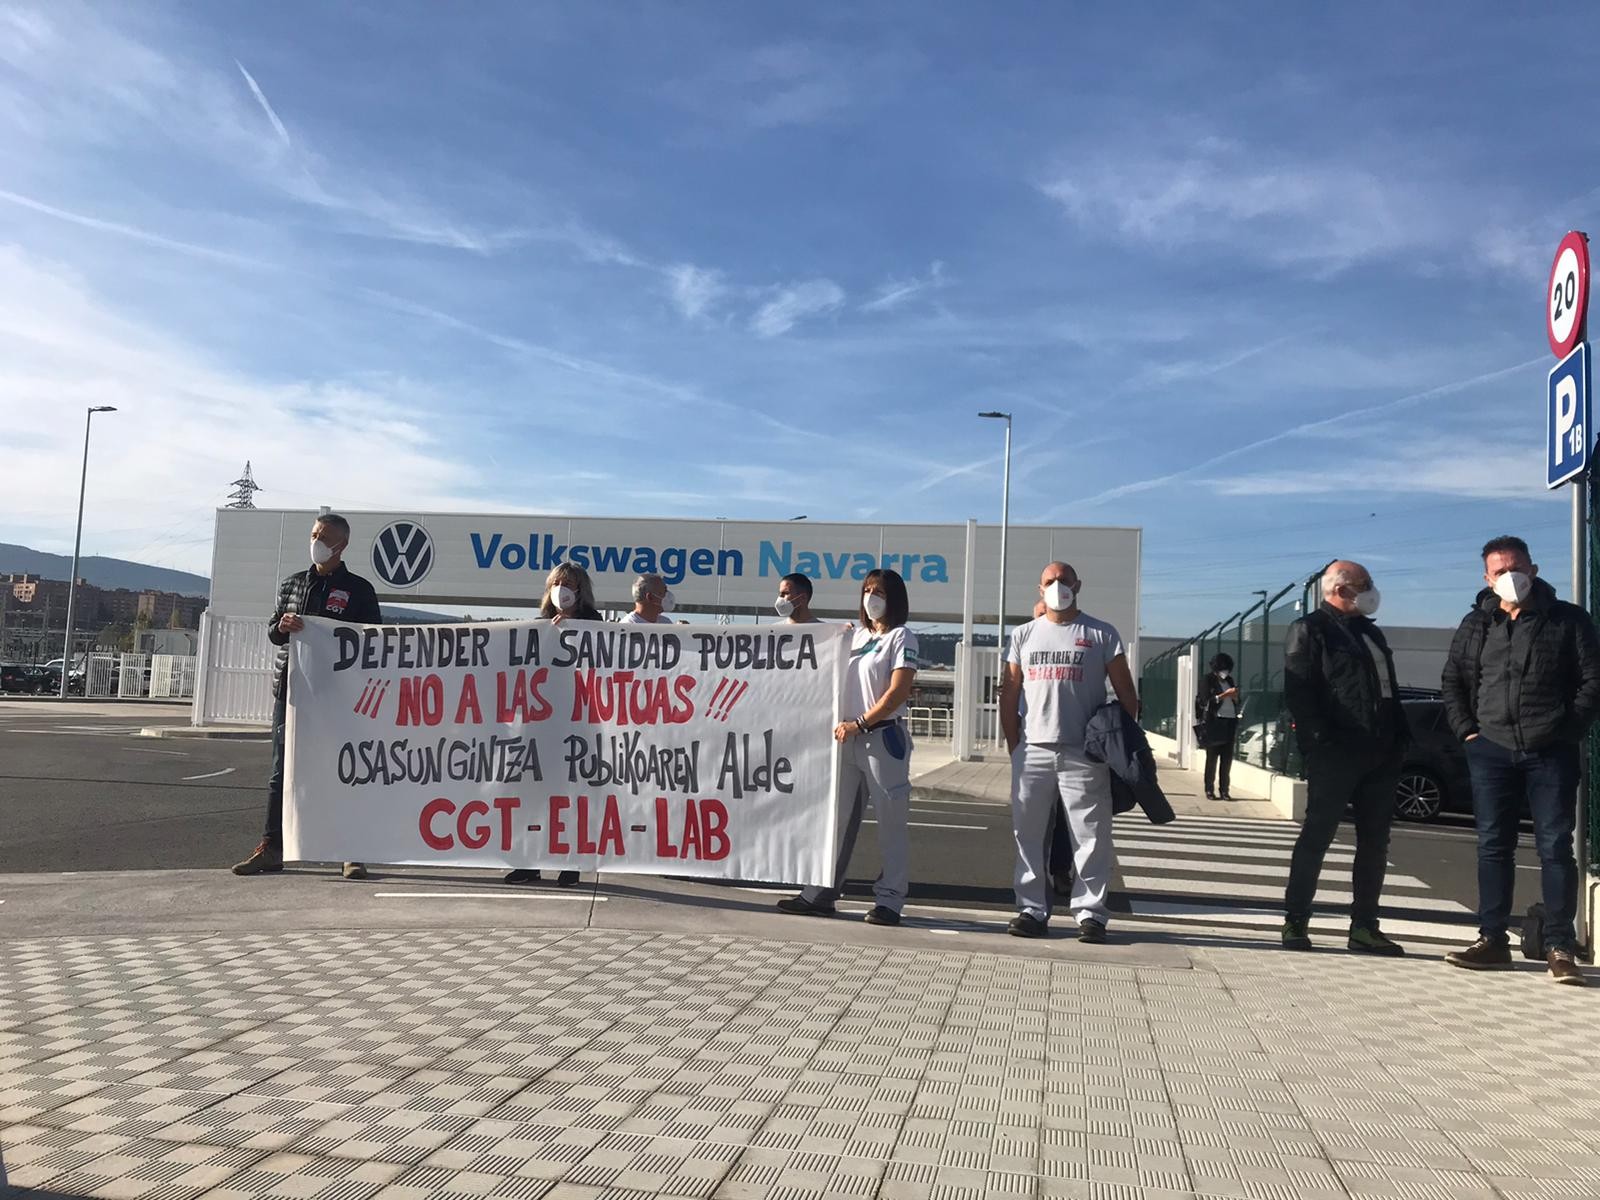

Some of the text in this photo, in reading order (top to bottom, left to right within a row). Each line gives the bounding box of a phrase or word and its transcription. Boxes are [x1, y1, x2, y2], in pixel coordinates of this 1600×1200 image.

[1554, 271, 1575, 321] 20
[1555, 374, 1577, 466] P
[1568, 423, 1583, 457] 1B
[470, 533, 949, 586] Volkswagen Navarra
[326, 604, 345, 614] CGT
[333, 627, 490, 671] DEFENDER
[509, 628, 540, 667] LA
[1073, 651, 1085, 665] EZ
[395, 673, 444, 727] NO
[454, 673, 483, 724] A
[496, 667, 553, 724] LAS
[570, 667, 697, 726] MUTUAS
